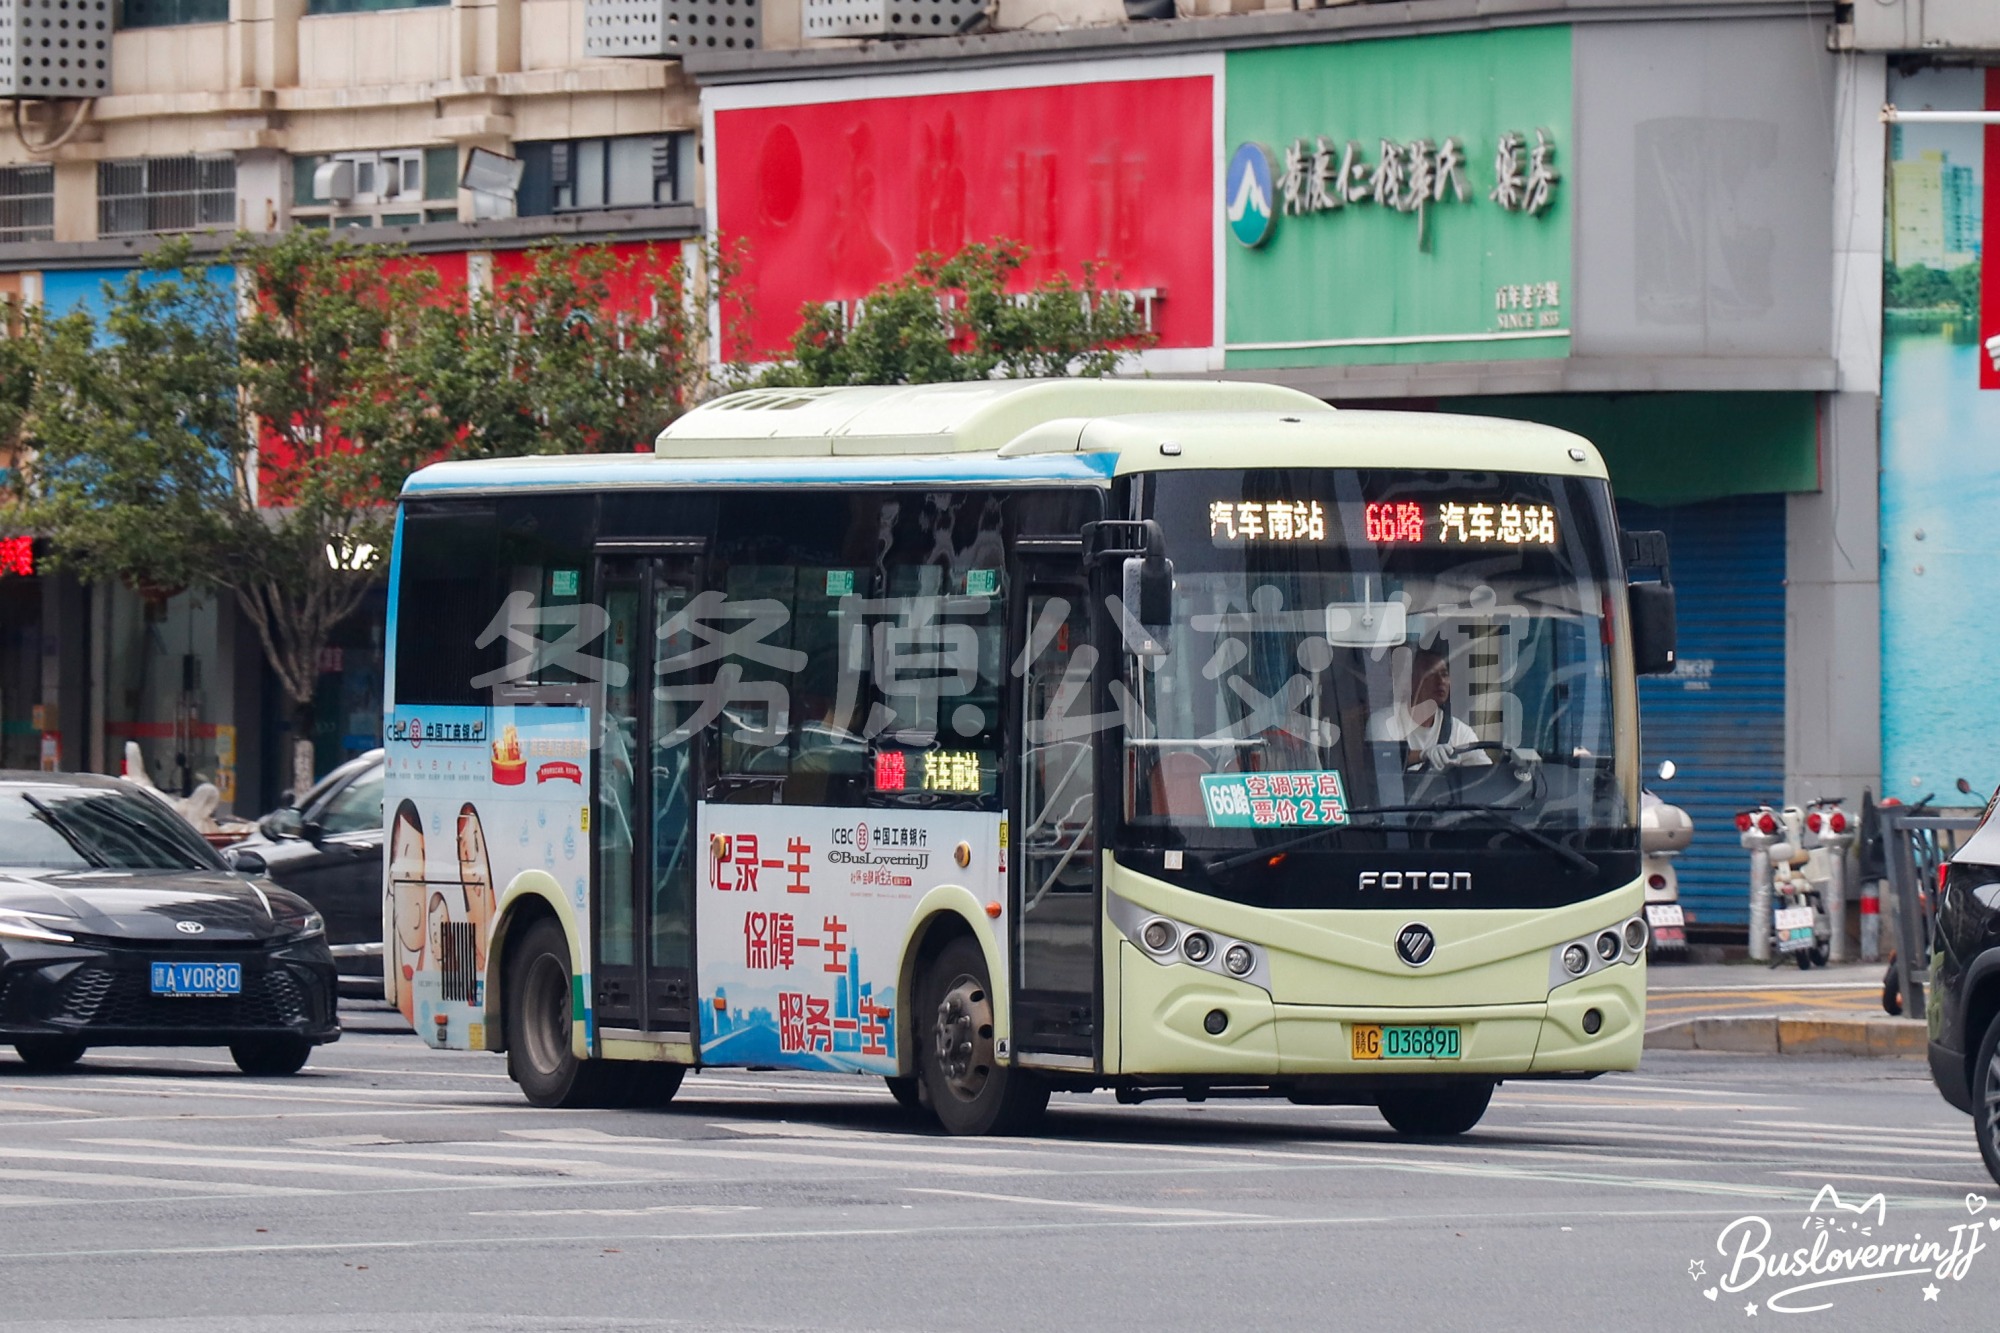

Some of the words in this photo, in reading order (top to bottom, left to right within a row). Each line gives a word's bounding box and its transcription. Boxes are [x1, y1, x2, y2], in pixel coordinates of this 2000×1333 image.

[1209, 500, 1325, 541] 汽车南站
[1365, 502, 1425, 543] 66路
[1437, 502, 1556, 544] 汽车总站
[385, 724, 408, 742] ICB
[923, 751, 980, 791] 汽车南站
[1246, 773, 1340, 797] 空调开启
[1209, 783, 1250, 815] 66路
[1251, 799, 1345, 824] 票价2元
[831, 828, 854, 845] ICBC
[873, 826, 928, 848] 中国工商银行
[709, 832, 811, 895] 记录一生
[1359, 871, 1472, 891] FOTON
[743, 911, 848, 974] 保障一生
[777, 992, 888, 1056] 服务一生
